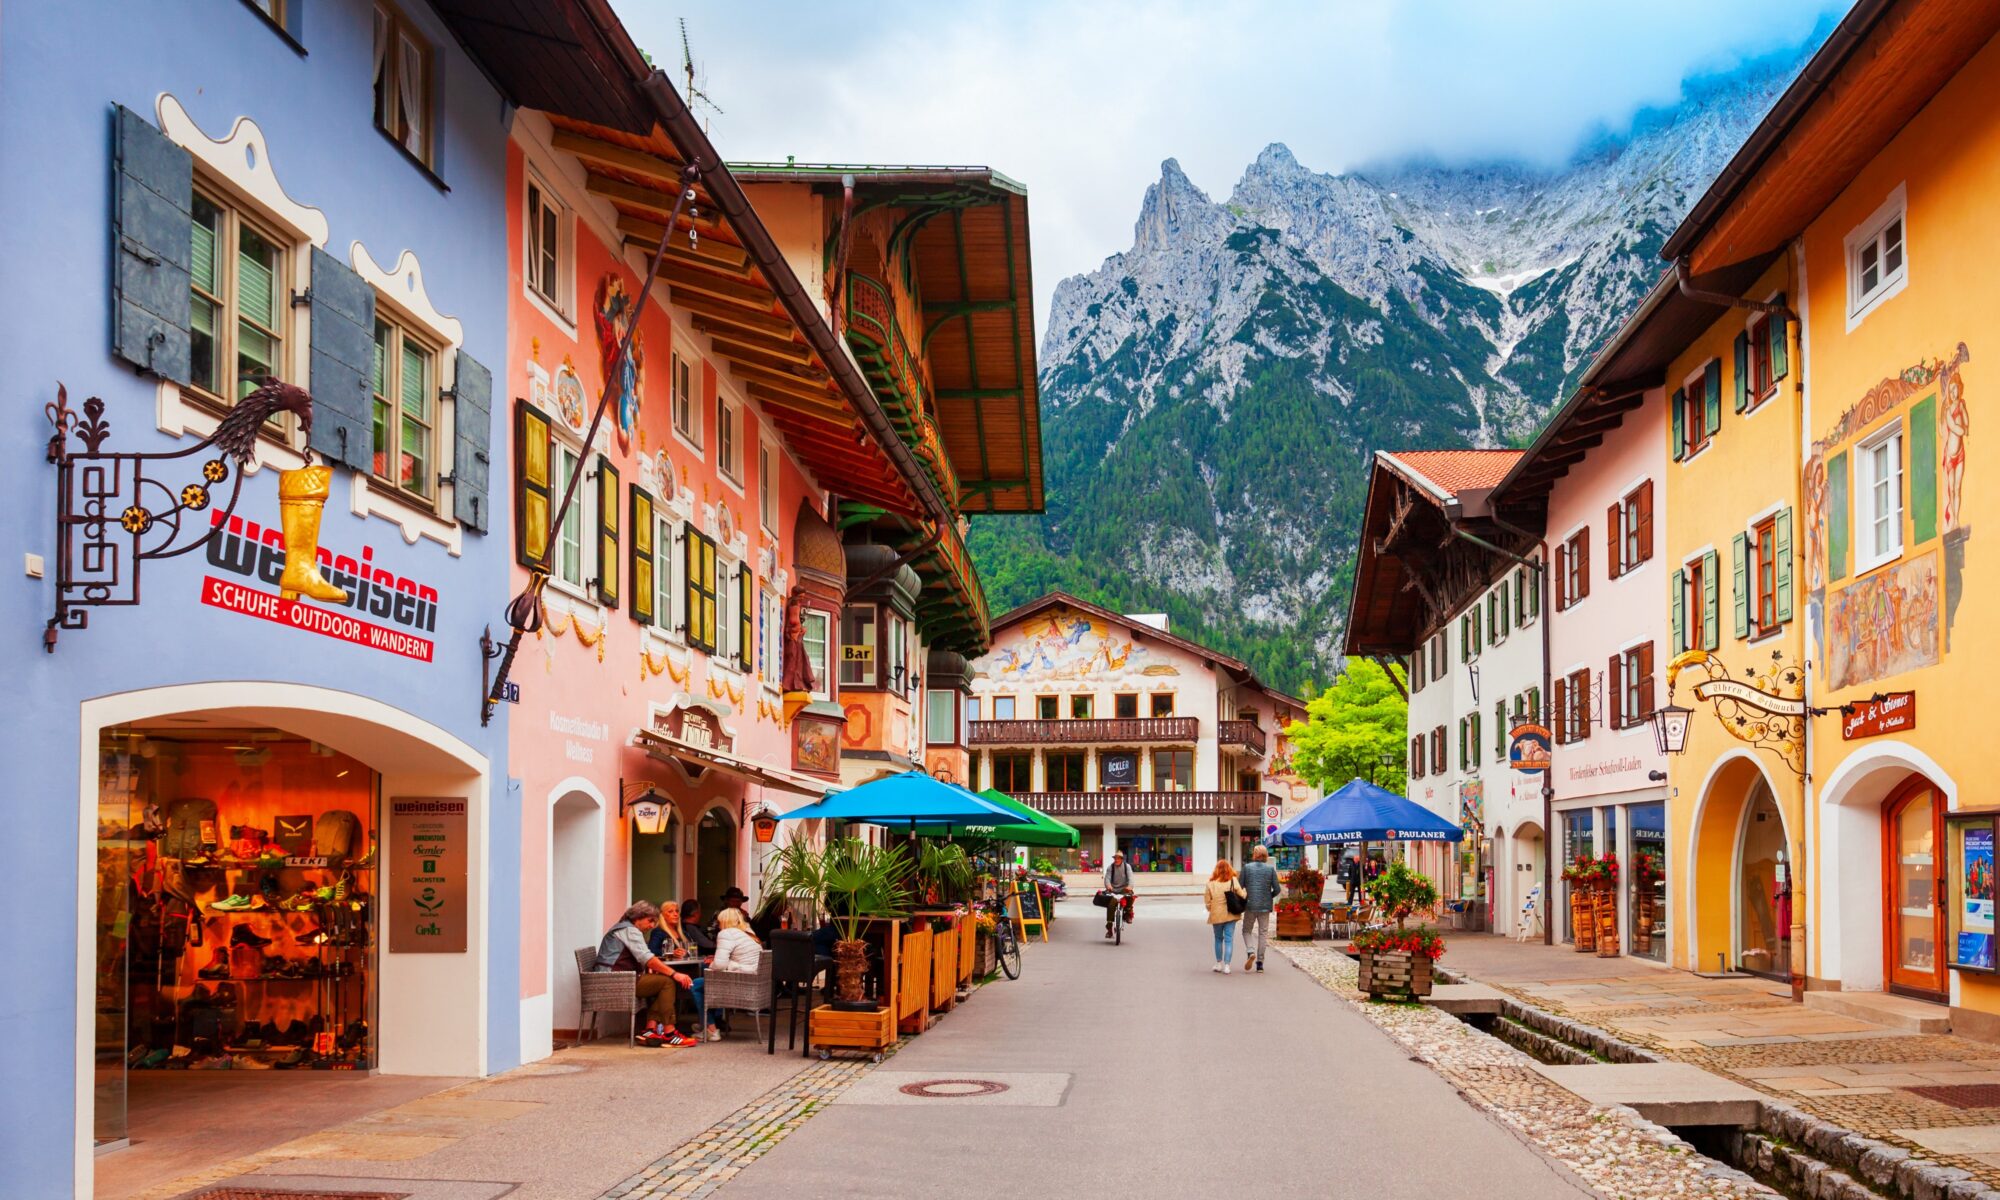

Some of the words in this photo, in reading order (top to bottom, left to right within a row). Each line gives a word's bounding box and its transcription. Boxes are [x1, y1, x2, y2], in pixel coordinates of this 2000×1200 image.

[206, 508, 438, 633] weneisen
[211, 582, 280, 619] SCHUHE
[290, 604, 360, 641] OUTDOOR
[370, 627, 428, 659] WANDERN
[845, 647, 870, 659] Bar
[1757, 696, 1795, 712] Schmuck
[1867, 706, 1877, 721] &
[565, 739, 593, 764] Wellness
[394, 800, 465, 812] weineisen
[638, 808, 657, 819] Zipfer
[1315, 831, 1363, 842] PAULANER
[1398, 829, 1446, 839] PAULANER
